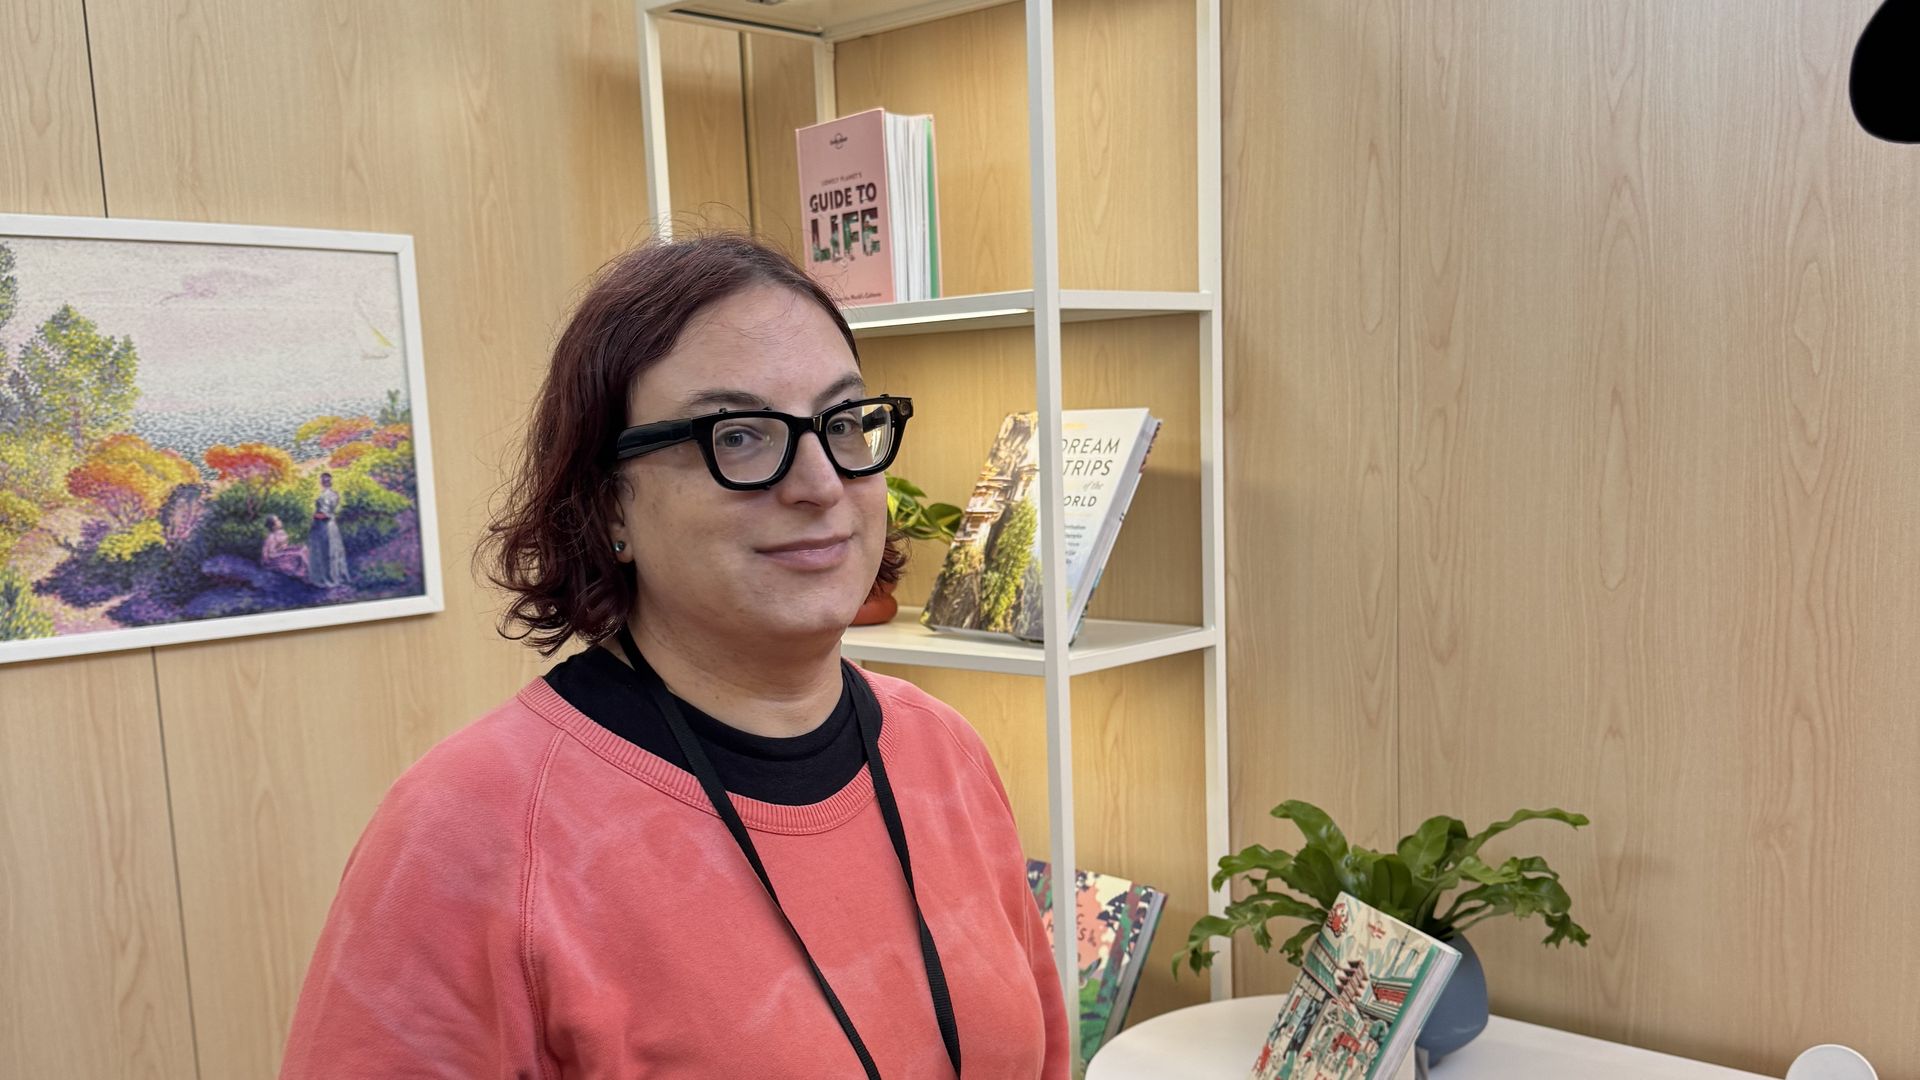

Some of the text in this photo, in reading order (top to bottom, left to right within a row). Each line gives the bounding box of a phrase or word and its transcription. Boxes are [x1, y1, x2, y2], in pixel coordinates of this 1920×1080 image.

[809, 182, 877, 214] GUIDE TO
[811, 207, 881, 263] LIFE
[1063, 459, 1113, 476] TRIPS
[1064, 495, 1097, 507] ORLD
